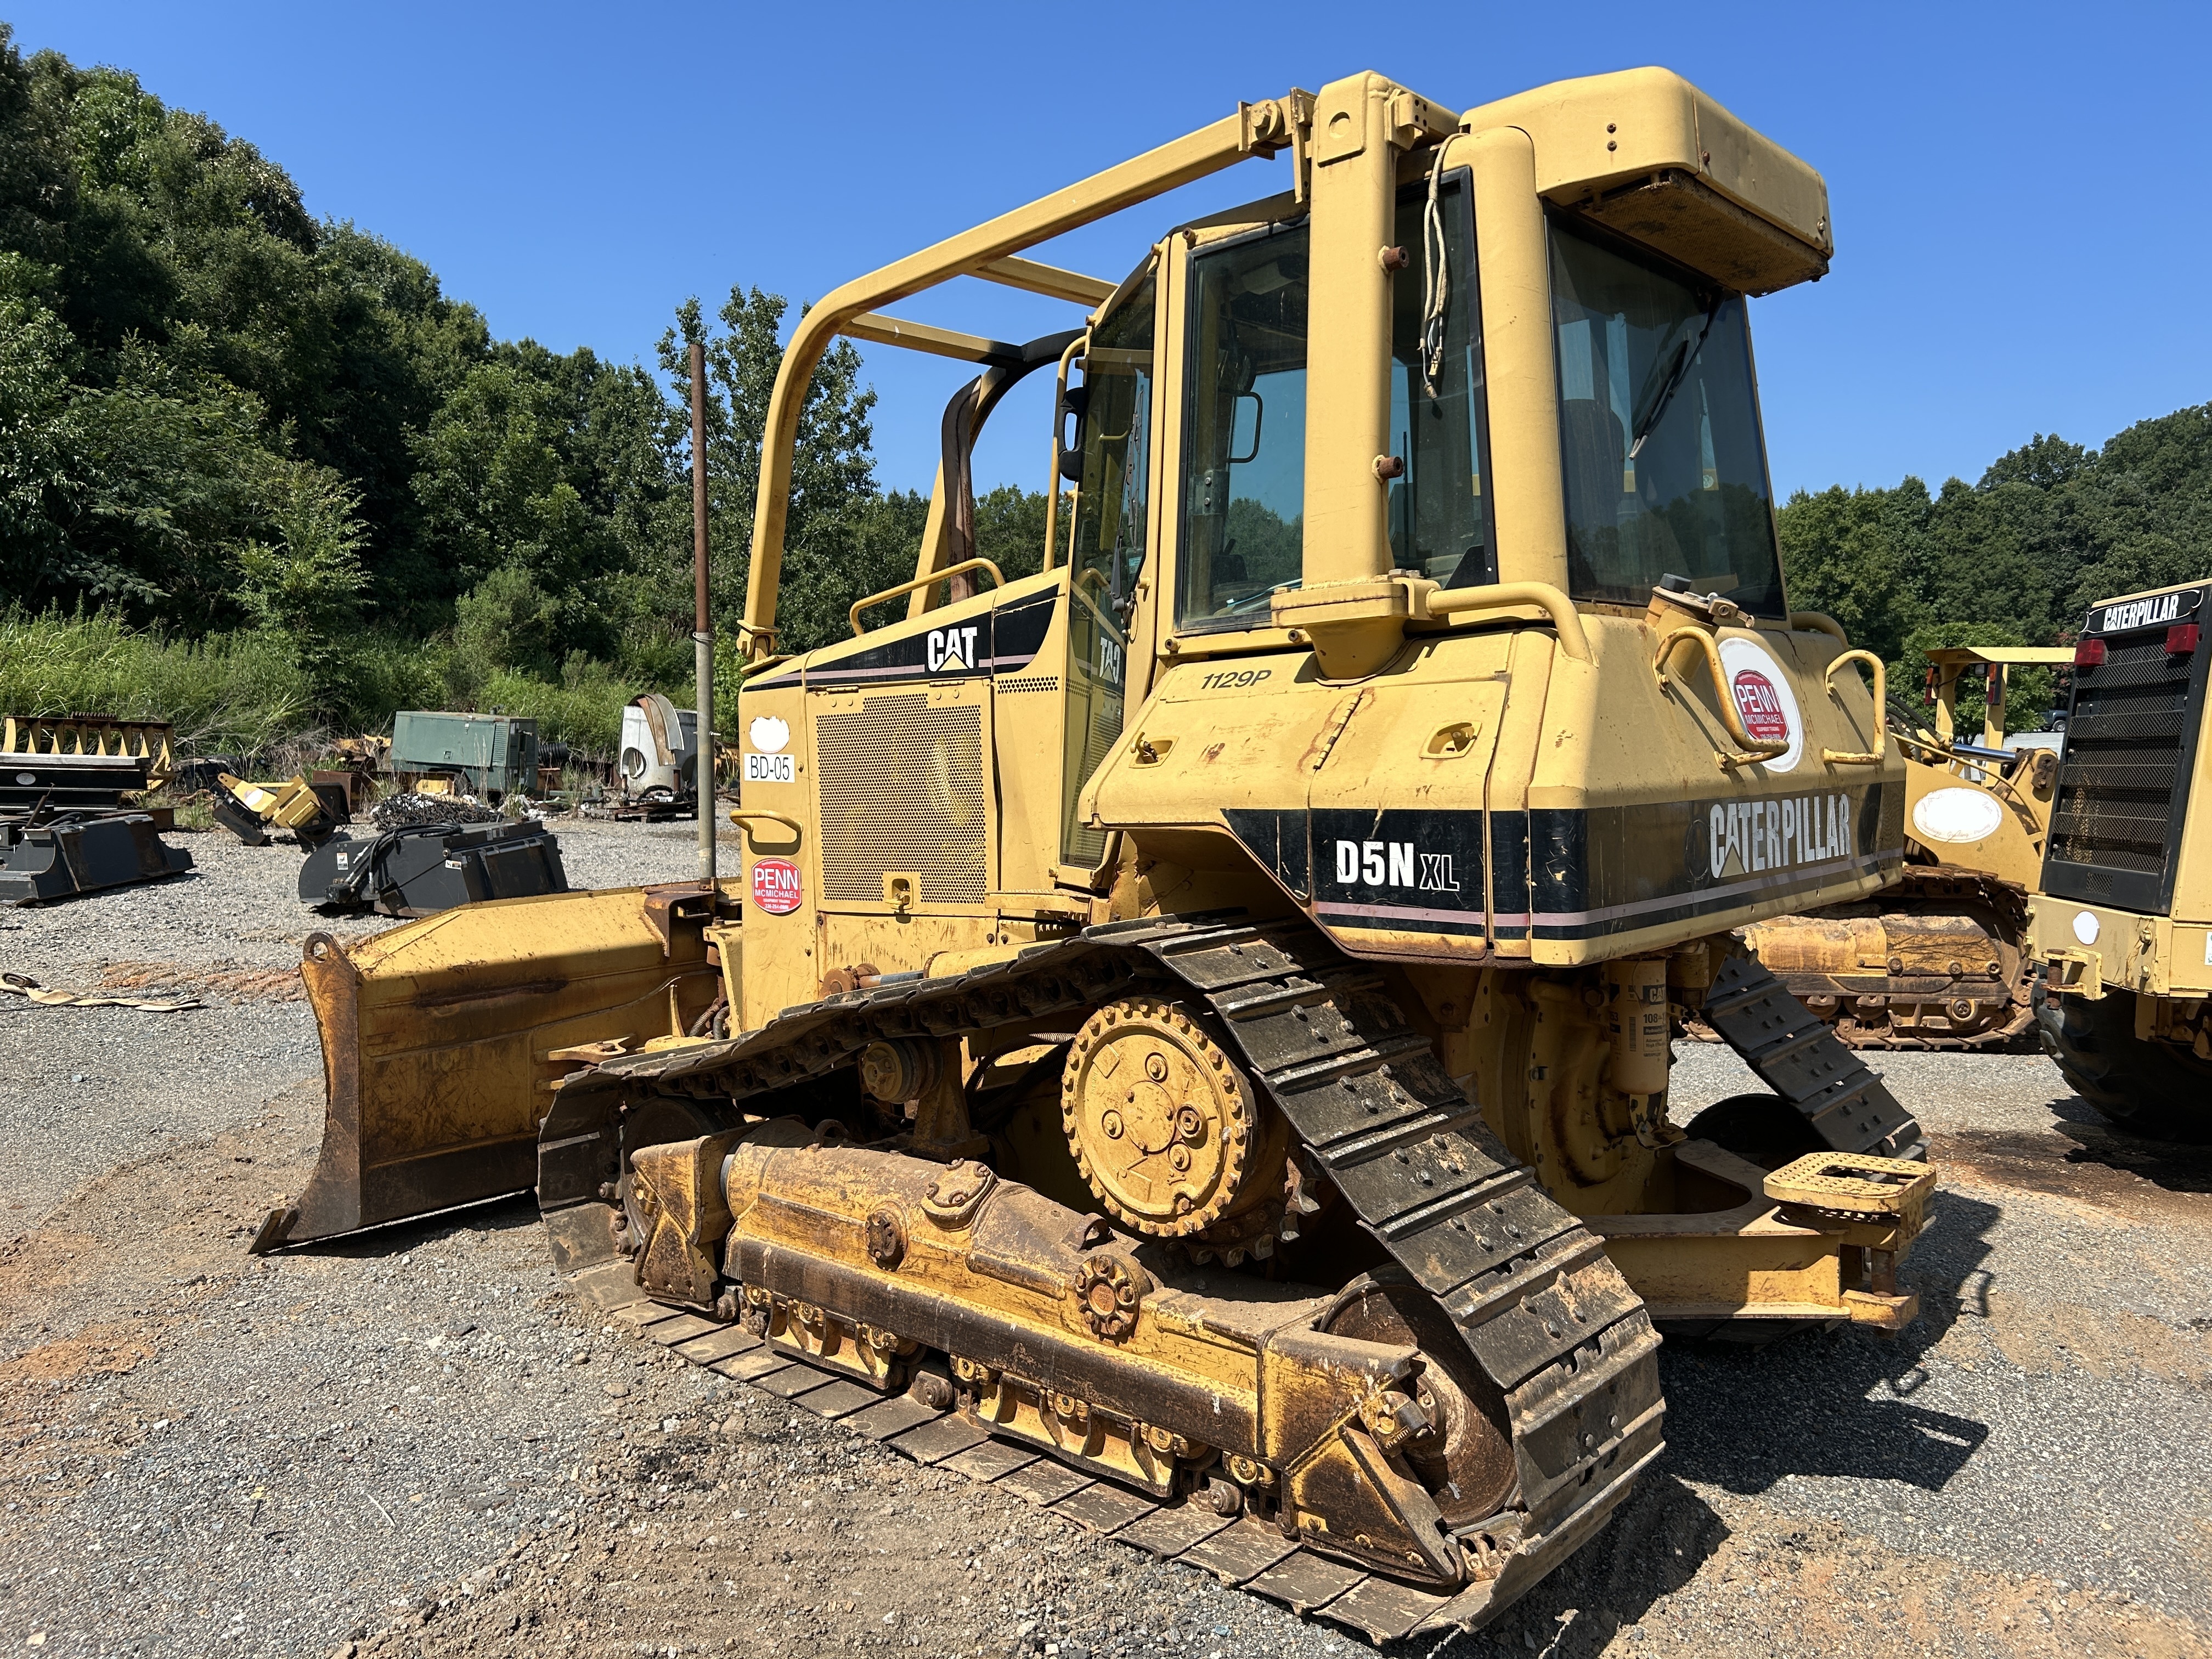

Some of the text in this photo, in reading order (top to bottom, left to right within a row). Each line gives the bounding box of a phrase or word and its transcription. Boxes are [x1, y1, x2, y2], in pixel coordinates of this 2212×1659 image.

[2103, 595, 2179, 631] CATERPILLAR
[928, 627, 977, 672] CAT
[1201, 669, 1272, 689] 1129P
[1736, 685, 1779, 712] PENN
[1745, 714, 1784, 724] MCMICHAEL
[751, 755, 789, 780] BD-05
[1710, 794, 1850, 878] CATERPILLAR
[754, 867, 798, 890] PENN
[1336, 840, 1460, 891] D5N XL
[755, 889, 799, 899] MCMICHAEL
